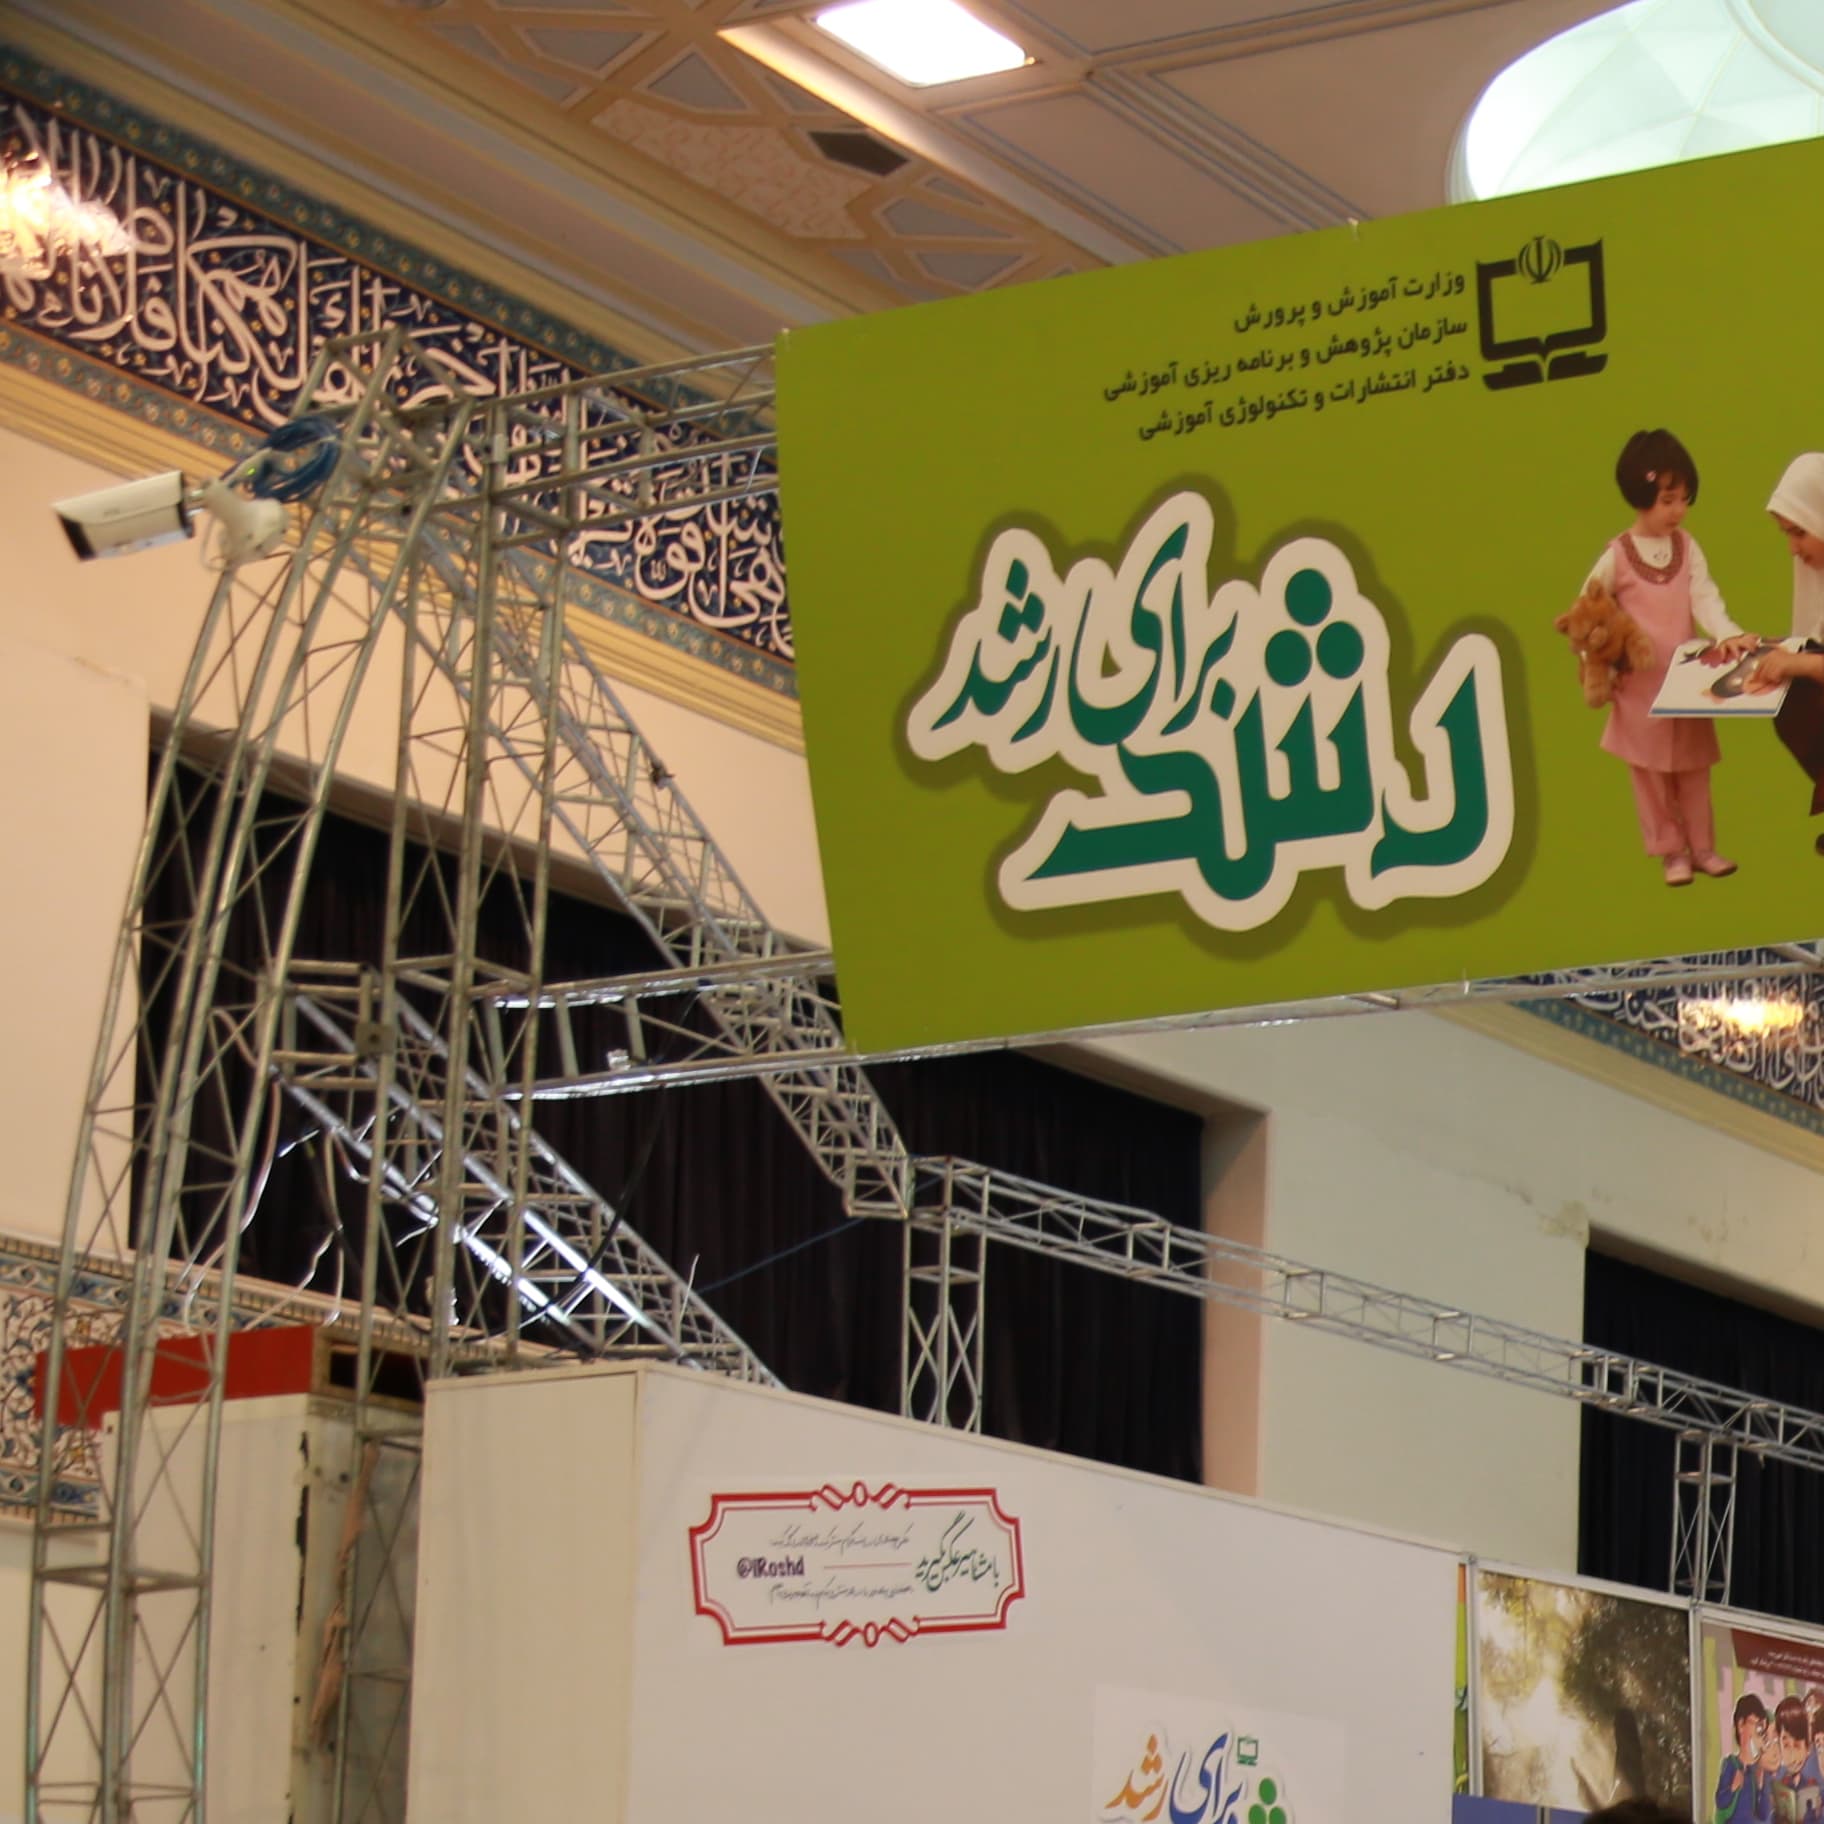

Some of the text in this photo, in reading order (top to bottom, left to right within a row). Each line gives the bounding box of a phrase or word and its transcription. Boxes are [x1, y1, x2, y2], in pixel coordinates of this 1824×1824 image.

[1233, 271, 1467, 333] وزارت آموزش و پرورش
[1102, 318, 1468, 402] سازمان پژوهش و برنامه ریزی آموزشی
[1137, 363, 1470, 441] دفتر انتشارات و تکنولوژی آموزشی
[942, 518, 1493, 902] رشد برای رشد
[1103, 1732, 1169, 1823] رشد
